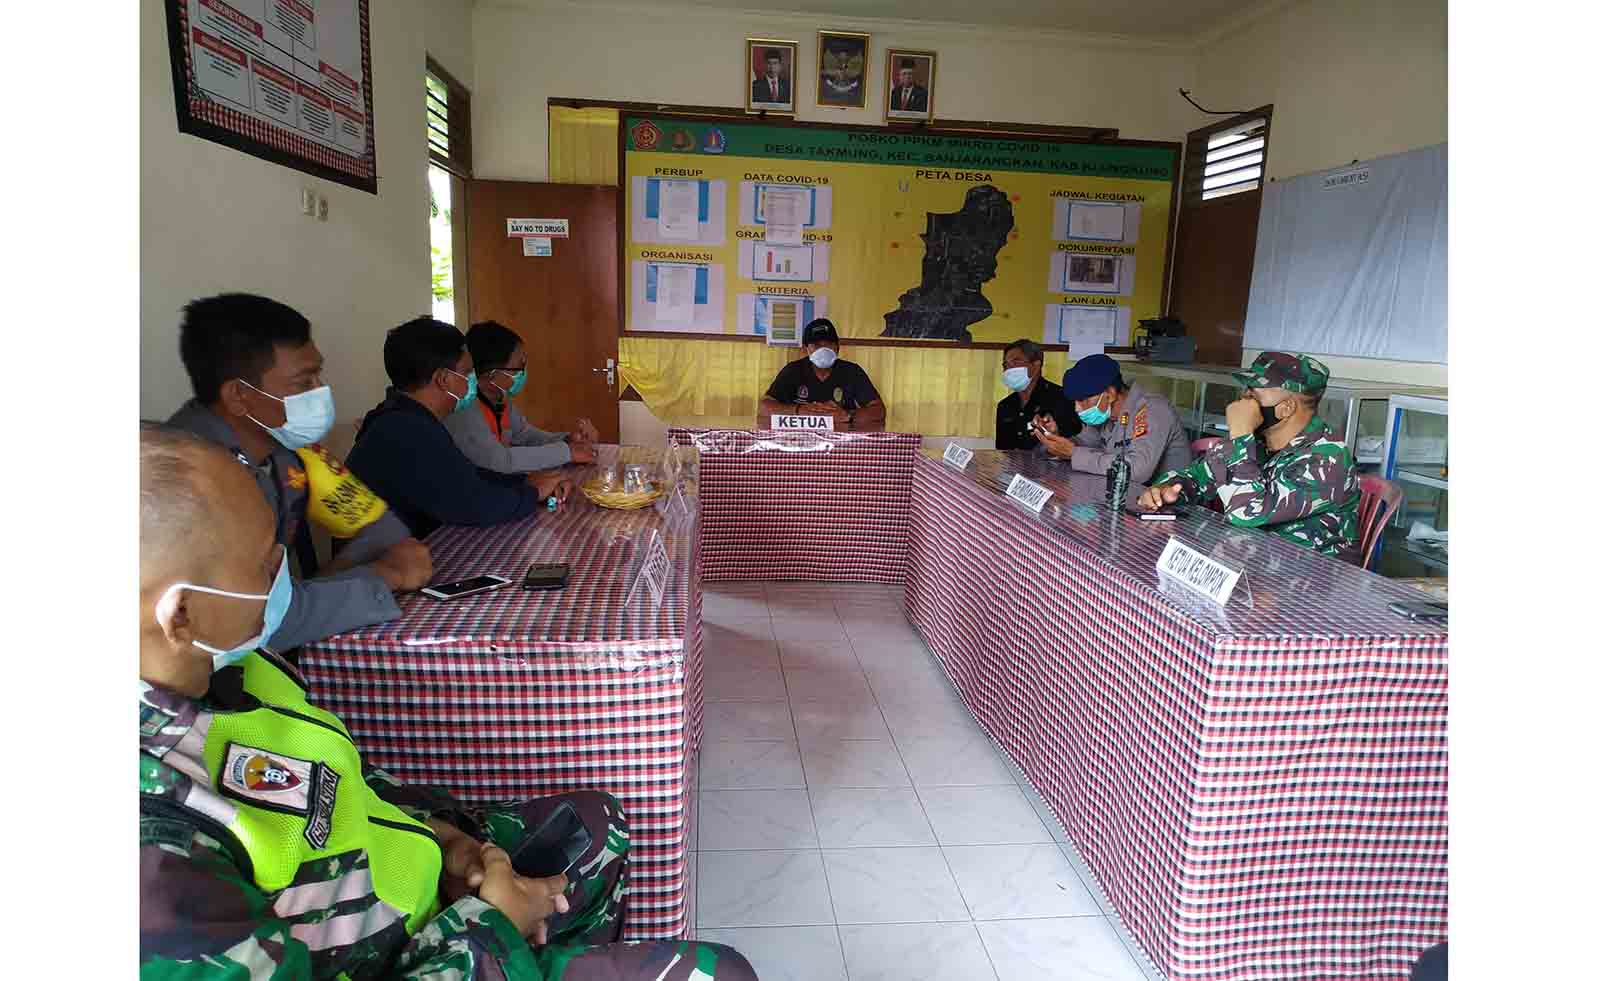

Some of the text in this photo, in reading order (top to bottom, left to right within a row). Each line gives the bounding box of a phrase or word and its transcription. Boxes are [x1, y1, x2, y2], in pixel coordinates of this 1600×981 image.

[655, 167, 704, 177] PERBUP
[915, 169, 993, 182] PETA DESA
[744, 173, 829, 185] DATA COVID-19
[1049, 190, 1093, 199] JADWAL
[544, 225, 566, 233] DRUGS
[1058, 243, 1135, 256] DOKUMENTASI
[641, 250, 713, 261] ORGANISASI
[757, 286, 809, 295] KRITERIA
[778, 416, 828, 429] KETUA
[1167, 545, 1196, 577] KETUA
